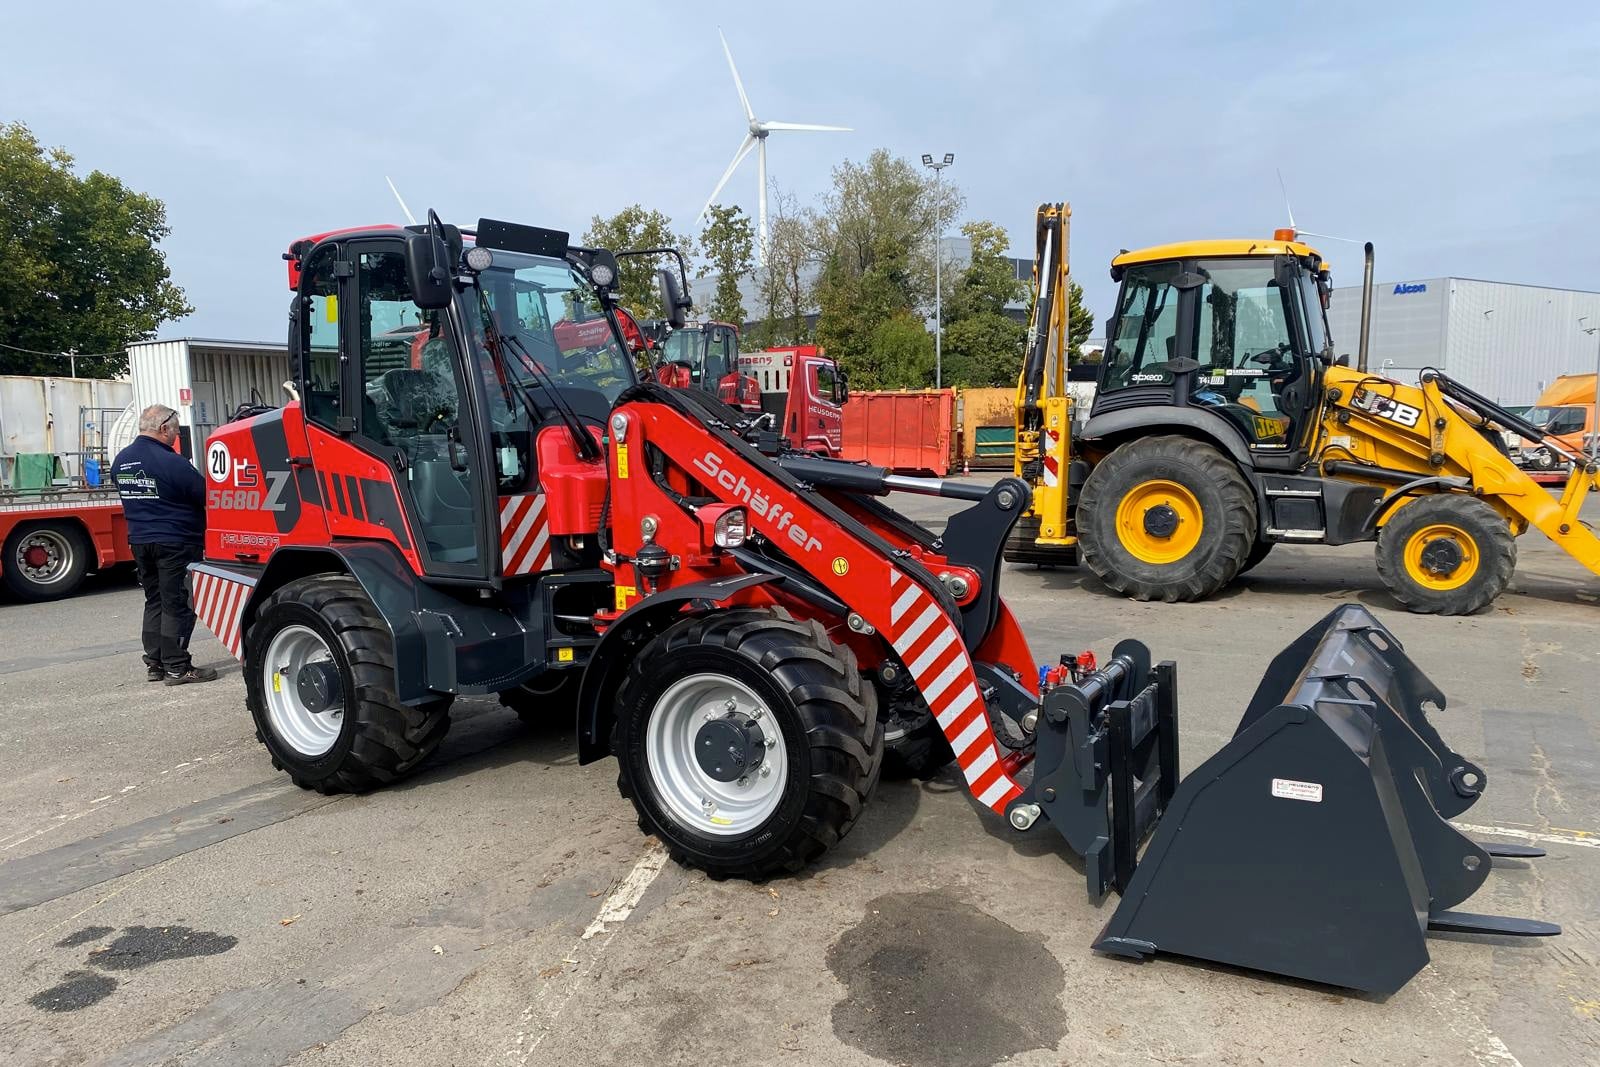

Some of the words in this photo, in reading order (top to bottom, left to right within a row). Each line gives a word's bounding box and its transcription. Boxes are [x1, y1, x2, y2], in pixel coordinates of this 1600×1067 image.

[212, 450, 226, 474] 20
[209, 490, 260, 511] 5680
[693, 452, 822, 552] Schäffer
